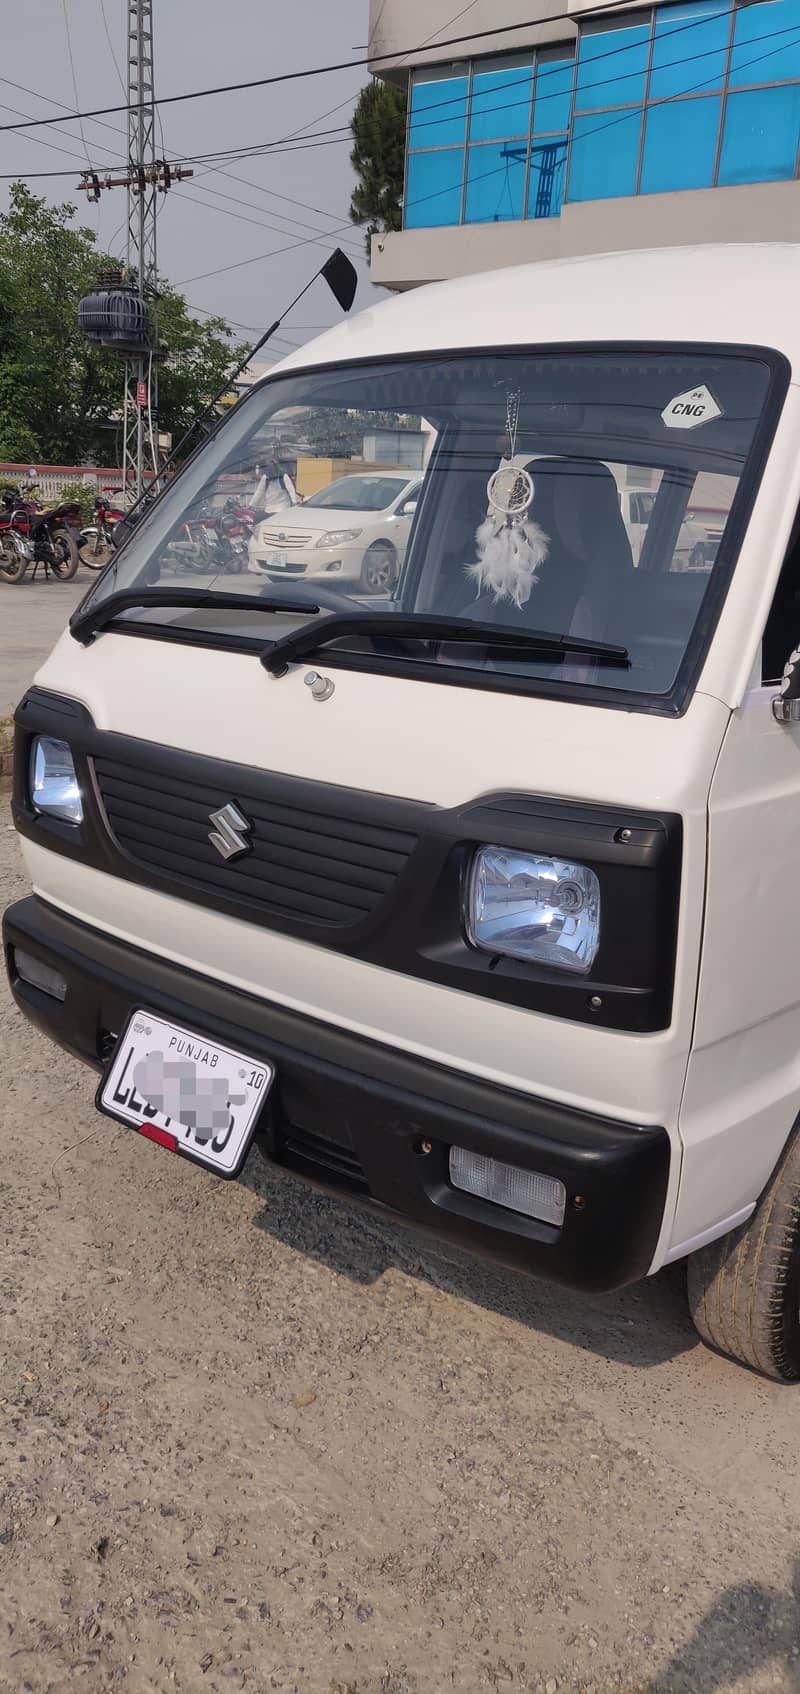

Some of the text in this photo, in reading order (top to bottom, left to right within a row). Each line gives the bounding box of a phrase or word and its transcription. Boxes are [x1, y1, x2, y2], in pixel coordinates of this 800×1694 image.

[672, 403, 706, 417] CNG
[168, 1036, 219, 1068] PUNJAB
[246, 1070, 264, 1089] 10
